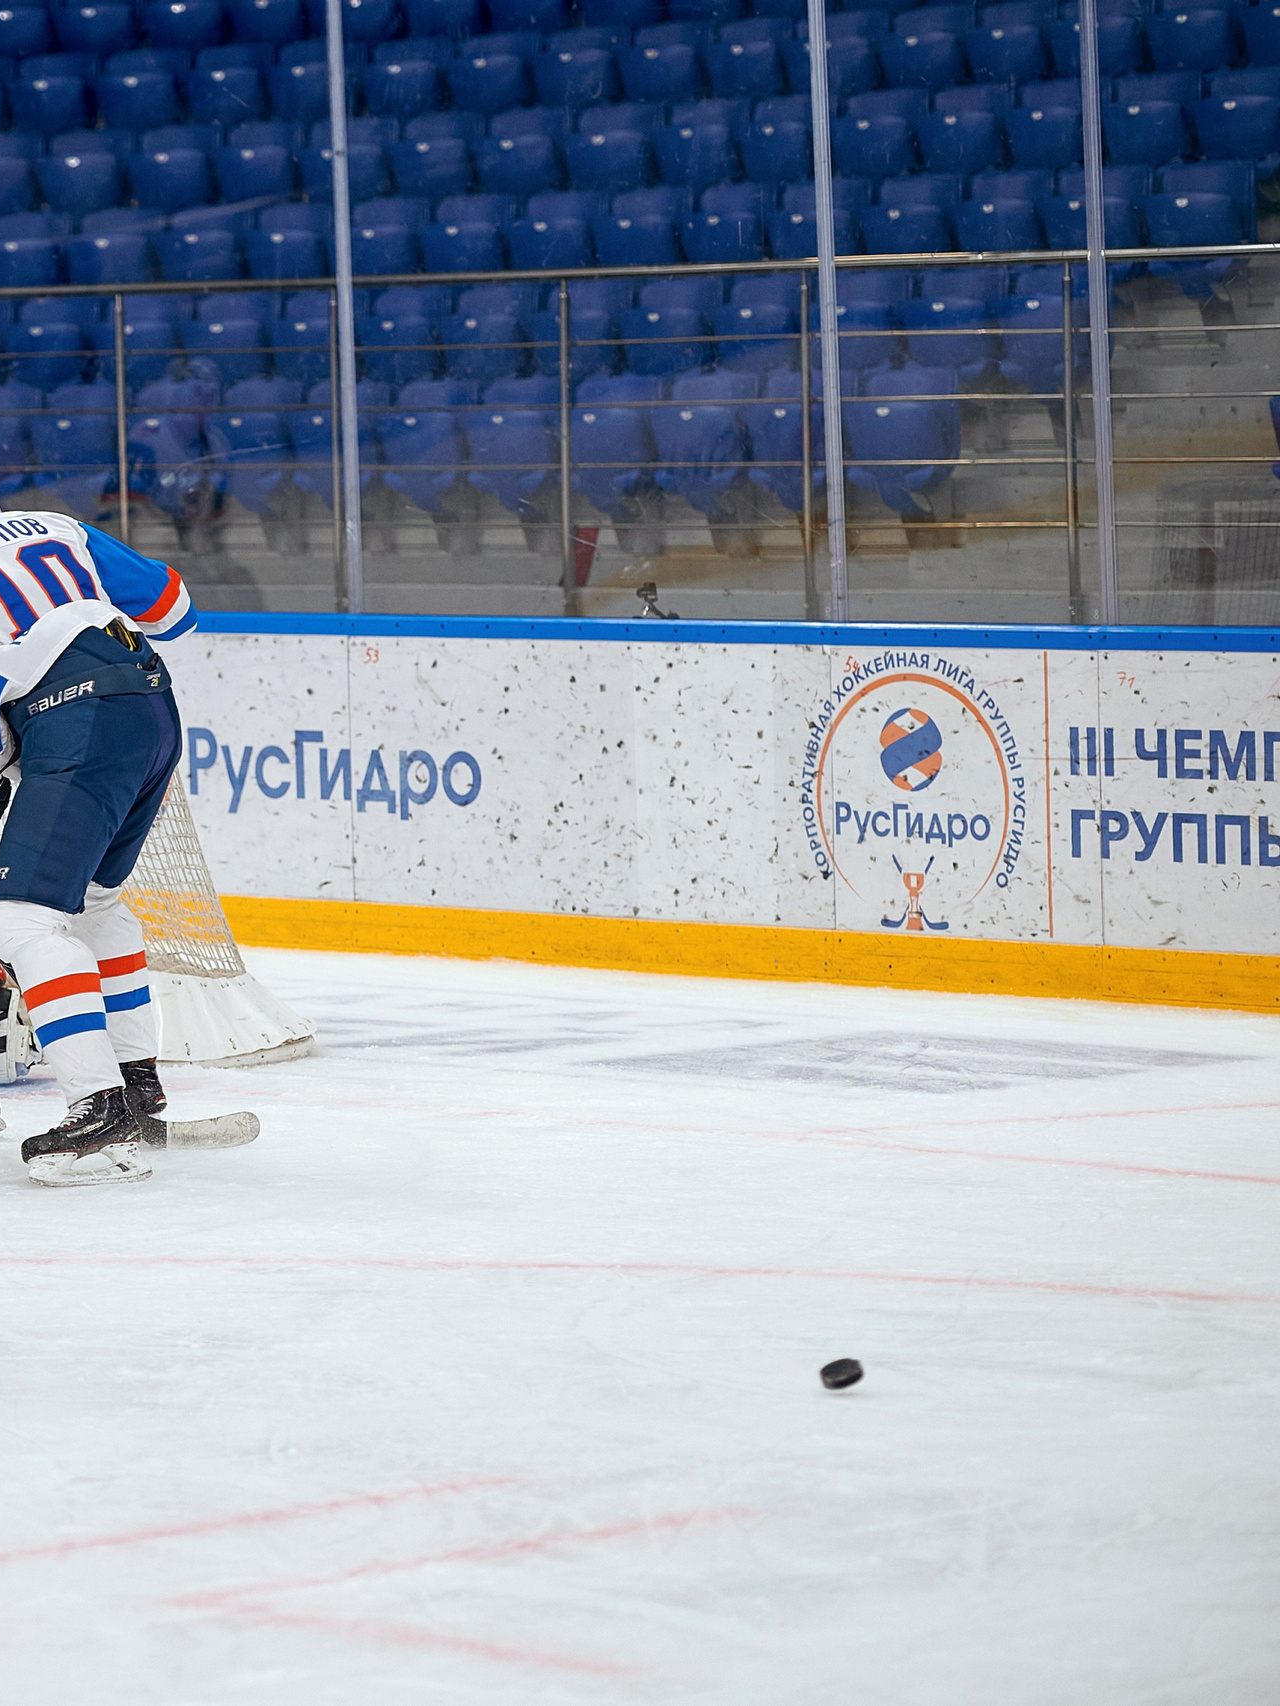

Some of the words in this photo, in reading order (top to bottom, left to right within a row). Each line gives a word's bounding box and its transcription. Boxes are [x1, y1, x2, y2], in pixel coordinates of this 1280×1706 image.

[363, 647, 380, 665] 53
[832, 651, 930, 703] ХОККЕЙНАЯ
[933, 658, 977, 695] ЛИГА
[27, 680, 96, 717] BAUER
[976, 689, 1022, 771] ГРУППЫ
[186, 726, 482, 820] РусГидро
[801, 699, 836, 880] КОРПОРАТИВНАЯ
[835, 801, 991, 848] РусГидро
[995, 776, 1026, 888] РУСГИДРО
